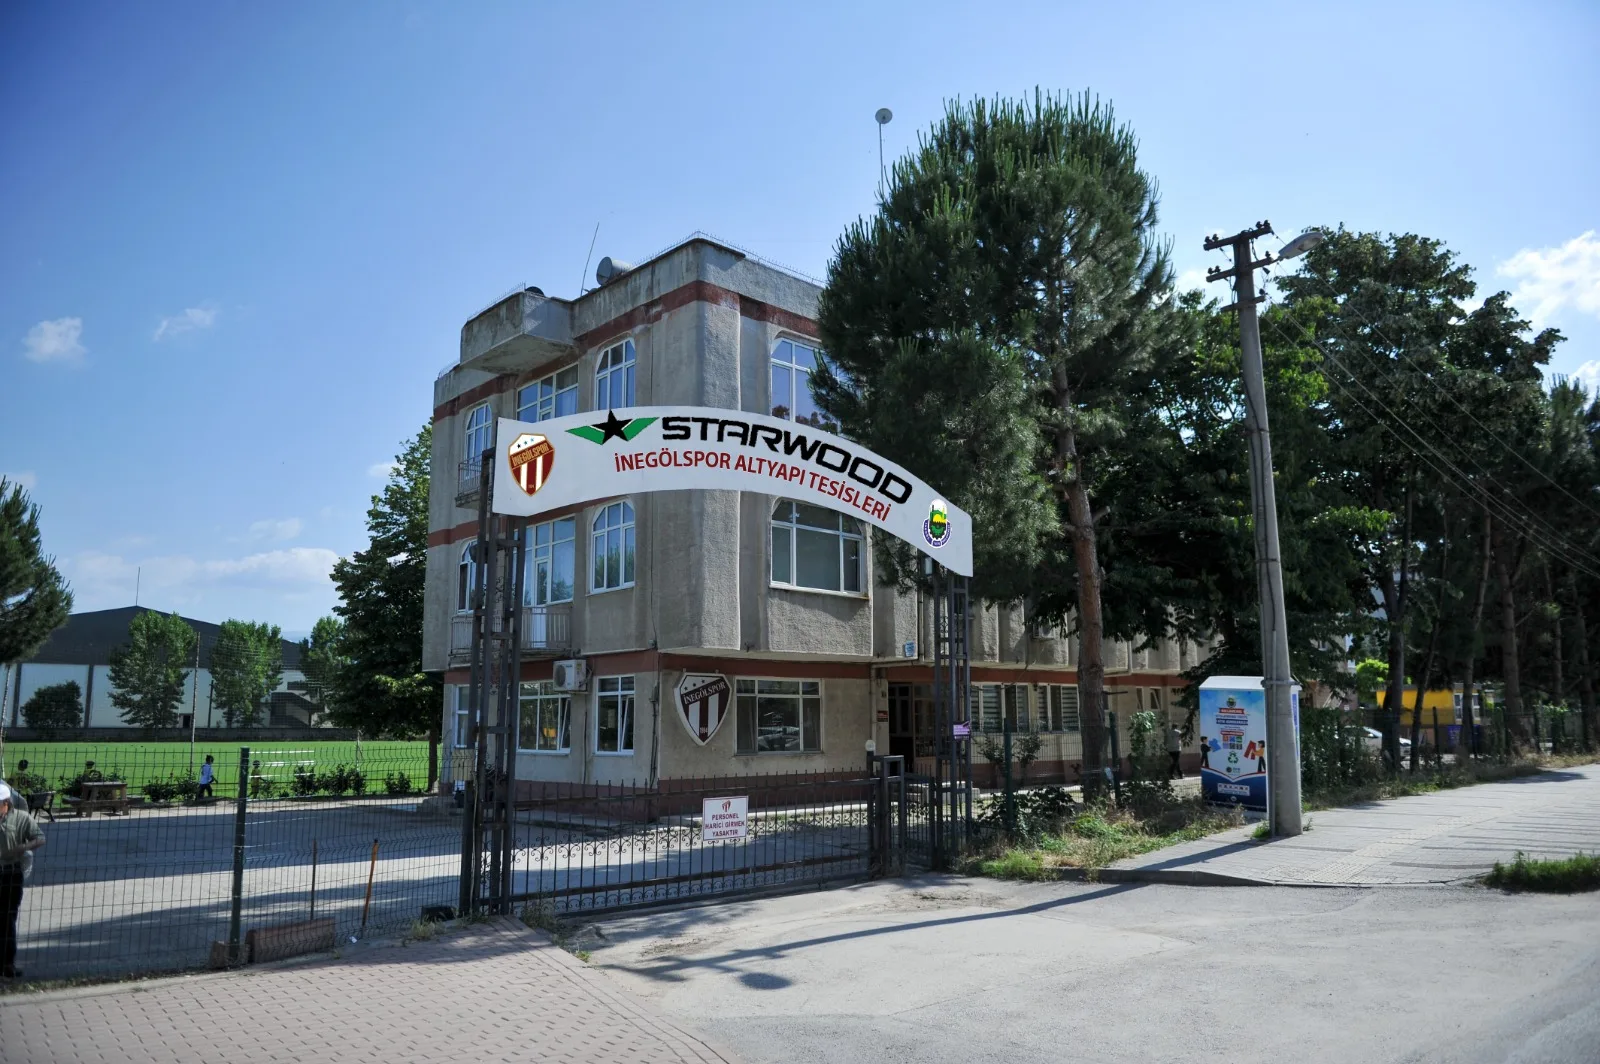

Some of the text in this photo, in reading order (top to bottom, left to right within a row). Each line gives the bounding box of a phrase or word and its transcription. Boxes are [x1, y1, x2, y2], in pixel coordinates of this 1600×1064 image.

[511, 442, 550, 467] İNEGÖLSPOR
[662, 416, 913, 504] STARWOOD
[614, 447, 892, 522] İNEGÖLSPOR ALTYAPI TESİSLERİ
[683, 681, 726, 705] İNEGÖLSPOR
[711, 813, 739, 821] PERSONEL
[725, 820, 745, 828] GİRMEK
[712, 829, 739, 837] YASAKTIR
